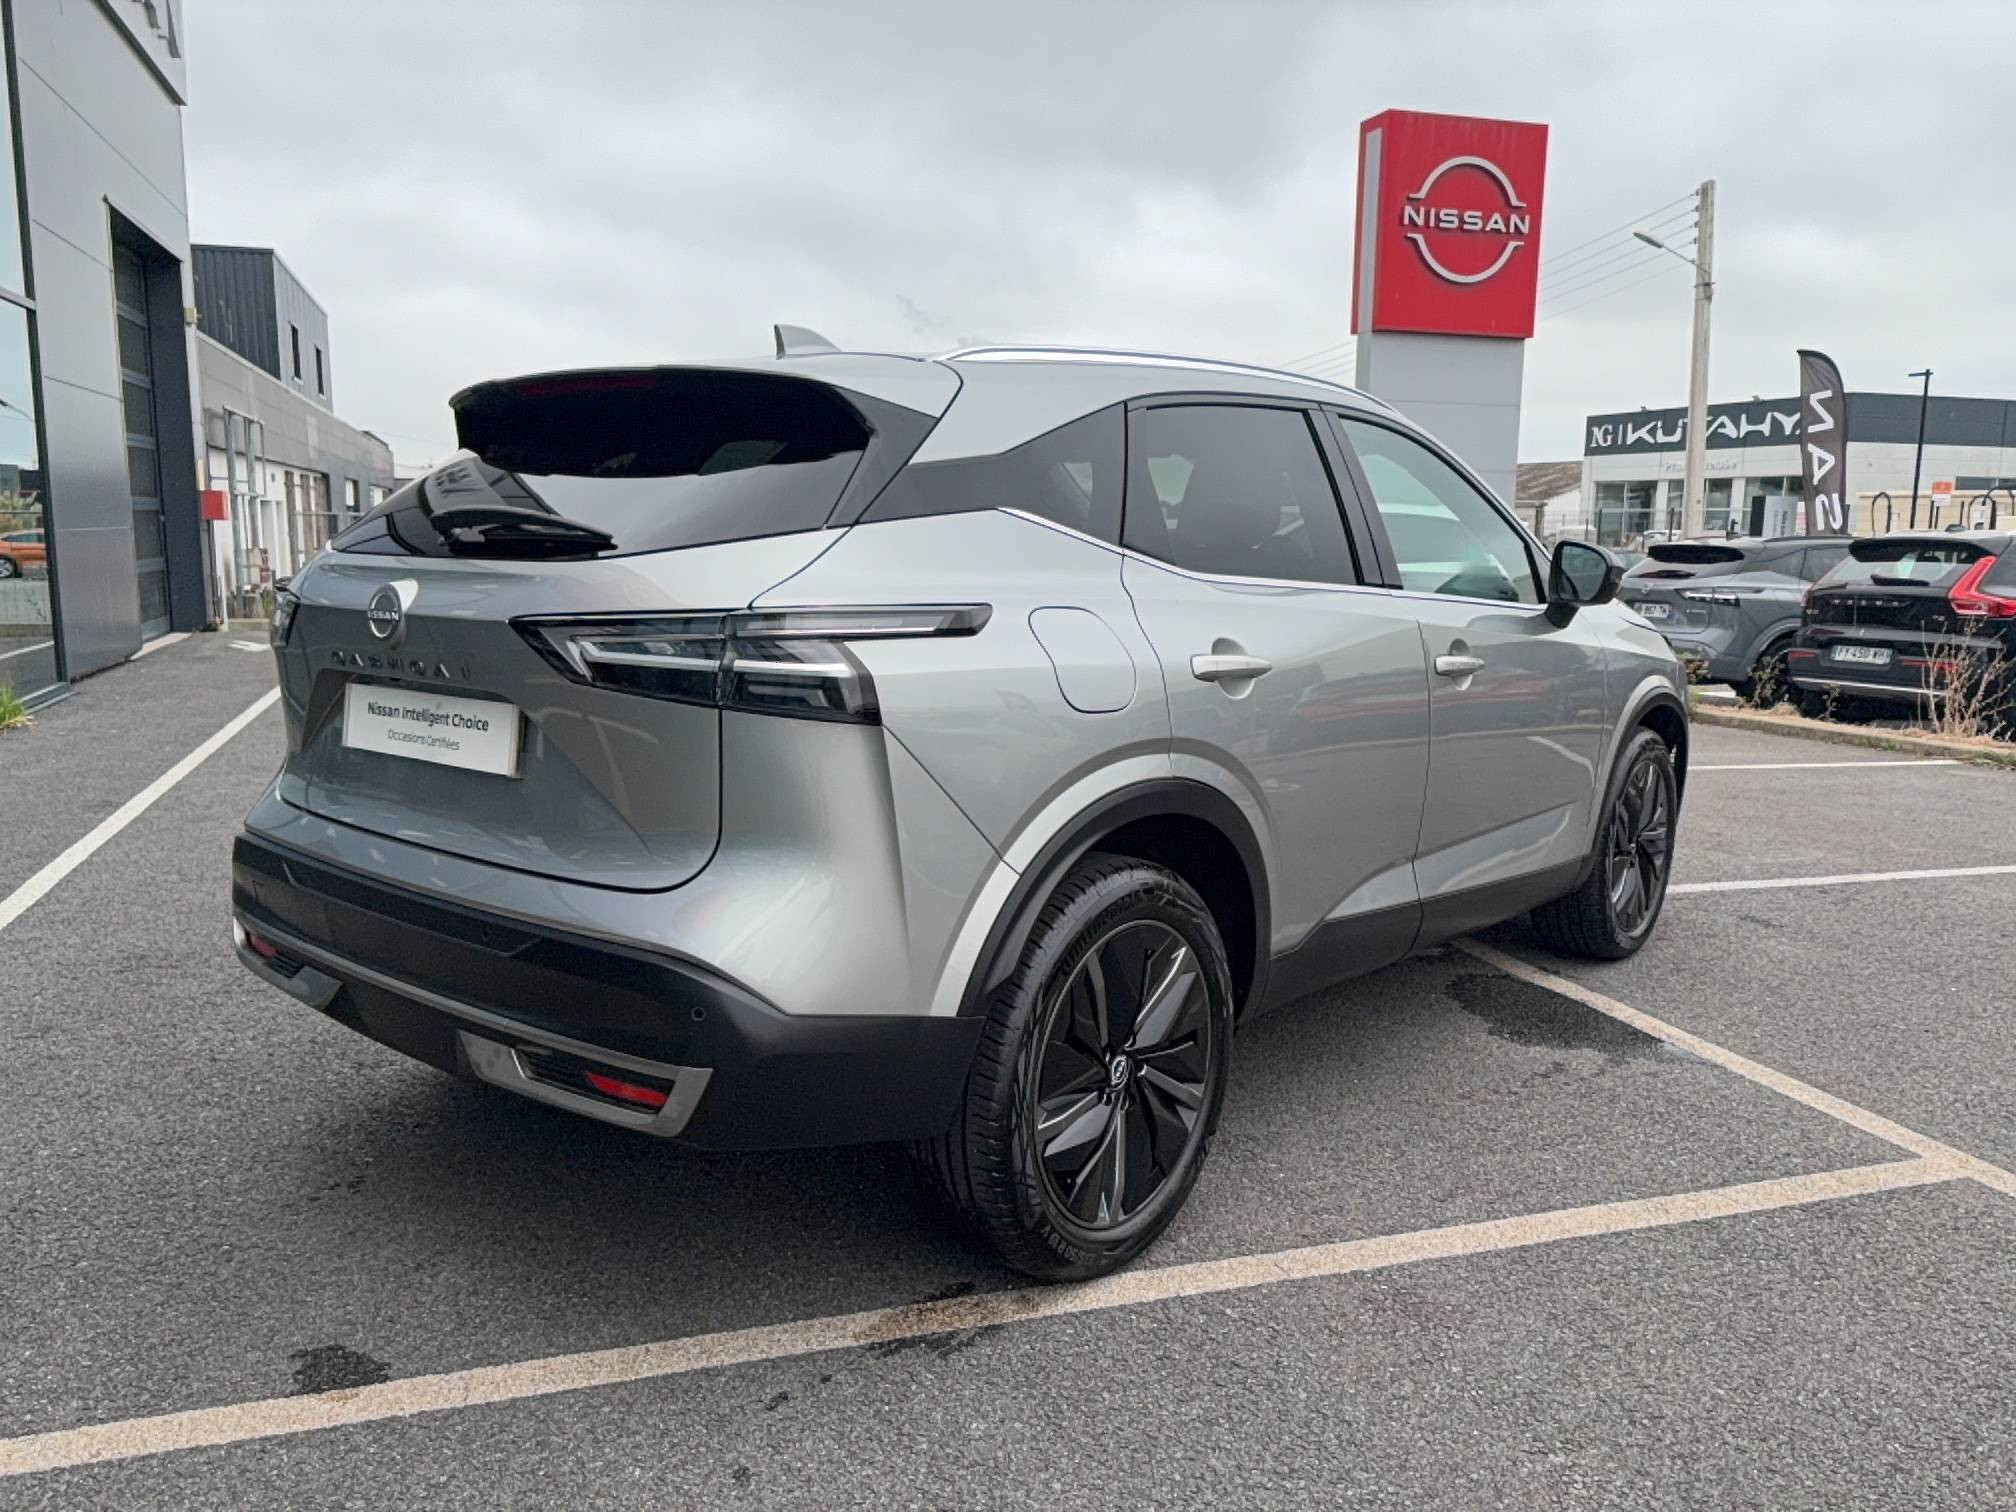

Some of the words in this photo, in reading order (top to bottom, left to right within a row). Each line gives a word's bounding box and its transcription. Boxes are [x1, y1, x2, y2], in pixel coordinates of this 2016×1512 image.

[1403, 205, 1531, 234] NISSAN
[1591, 424, 1614, 448] NG
[1627, 411, 1802, 445] KUAHY
[367, 702, 400, 719] Nissan
[401, 709, 451, 727] Intelligent
[451, 715, 489, 732] Choice
[387, 729, 427, 746] Occasions
